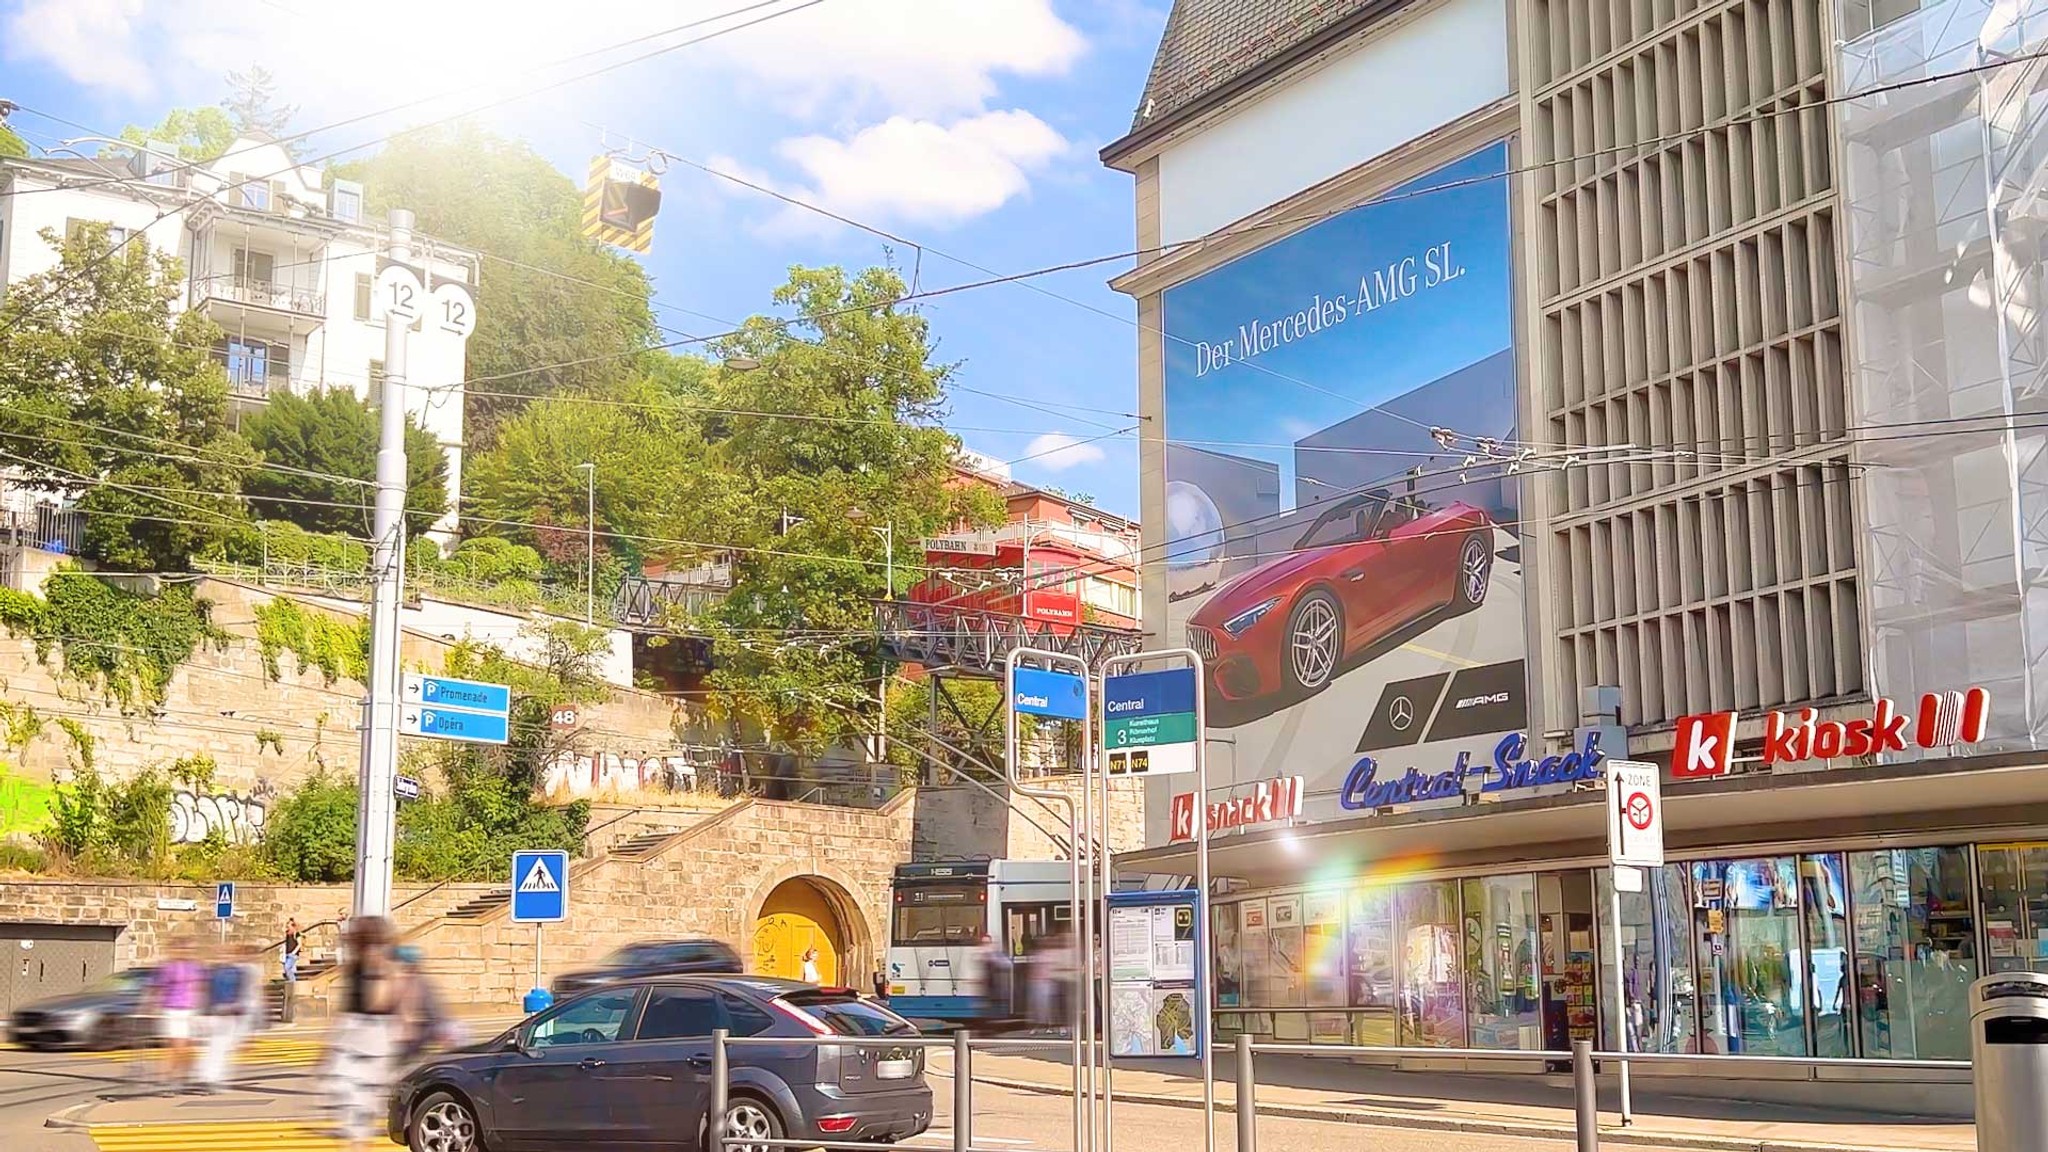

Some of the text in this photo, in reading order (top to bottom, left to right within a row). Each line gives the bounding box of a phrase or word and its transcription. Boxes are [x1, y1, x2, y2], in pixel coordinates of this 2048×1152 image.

[389, 281, 414, 310] 12
[442, 299, 465, 326] 12
[1196, 241, 1466, 377] Der Mercedes-AMG SL.
[925, 539, 967, 551] POLYBAHN
[440, 685, 488, 703] Promenade
[1017, 692, 1048, 708] Central
[1472, 692, 1509, 706] AMG
[1107, 698, 1144, 713] Central
[438, 715, 464, 732] Opéra
[552, 709, 575, 725] 48
[1117, 729, 1127, 745] 3
[1687, 698, 1911, 772] k kiosk
[1110, 757, 1148, 771] N71 N74
[1627, 773, 1651, 787] ZONE
[1206, 781, 1272, 831] snack
